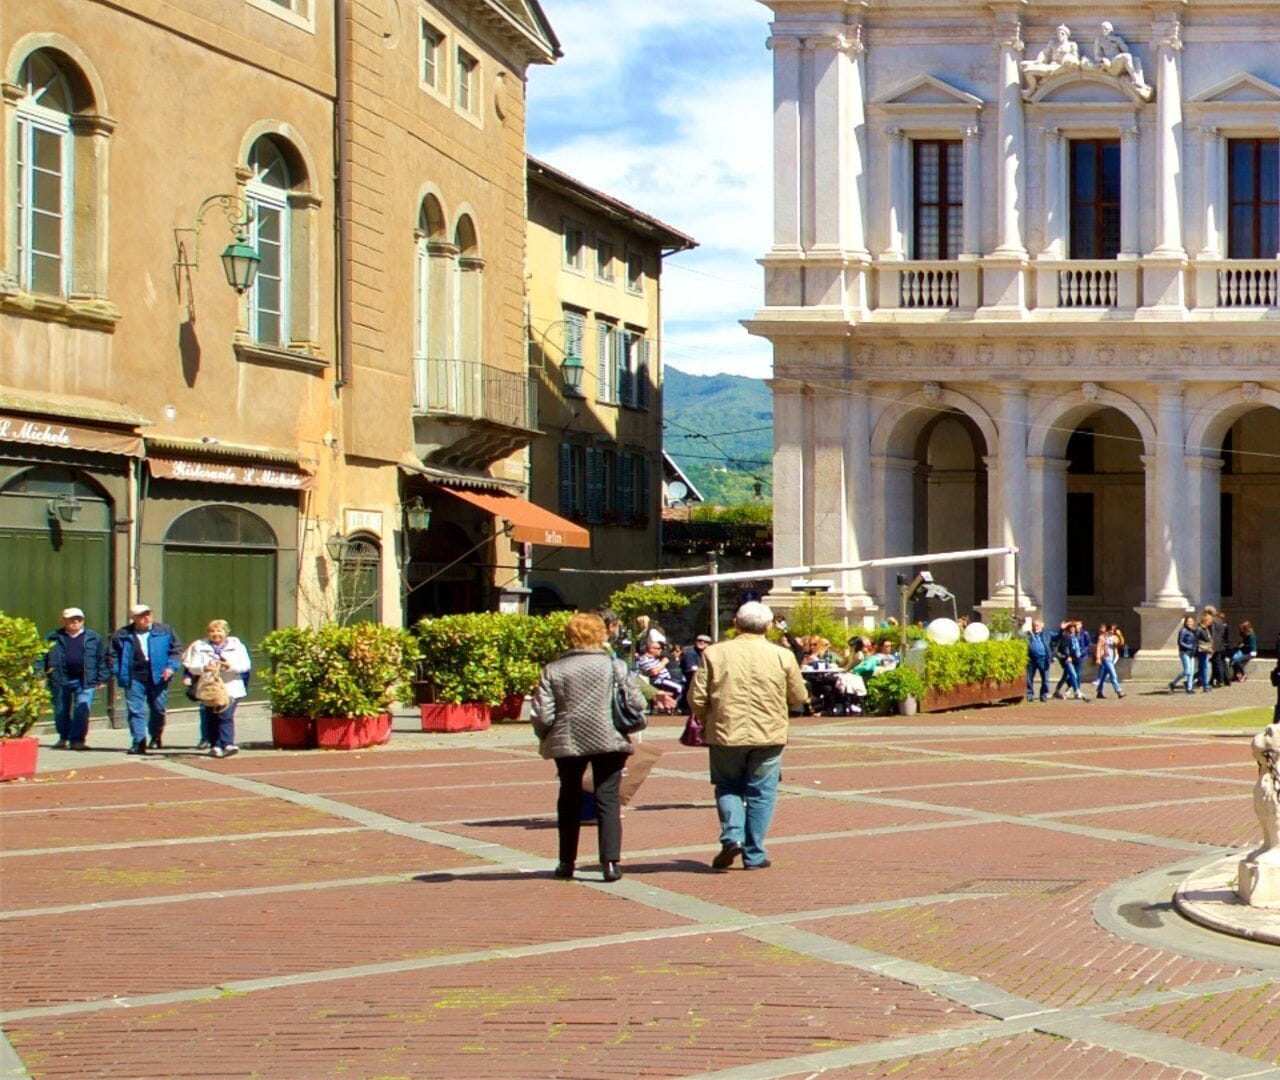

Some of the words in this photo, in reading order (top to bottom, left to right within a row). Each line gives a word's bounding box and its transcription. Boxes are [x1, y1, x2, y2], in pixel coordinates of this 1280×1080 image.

[12, 422, 70, 444] Michele
[172, 460, 236, 481] Ristorante
[256, 469, 301, 486] Michele
